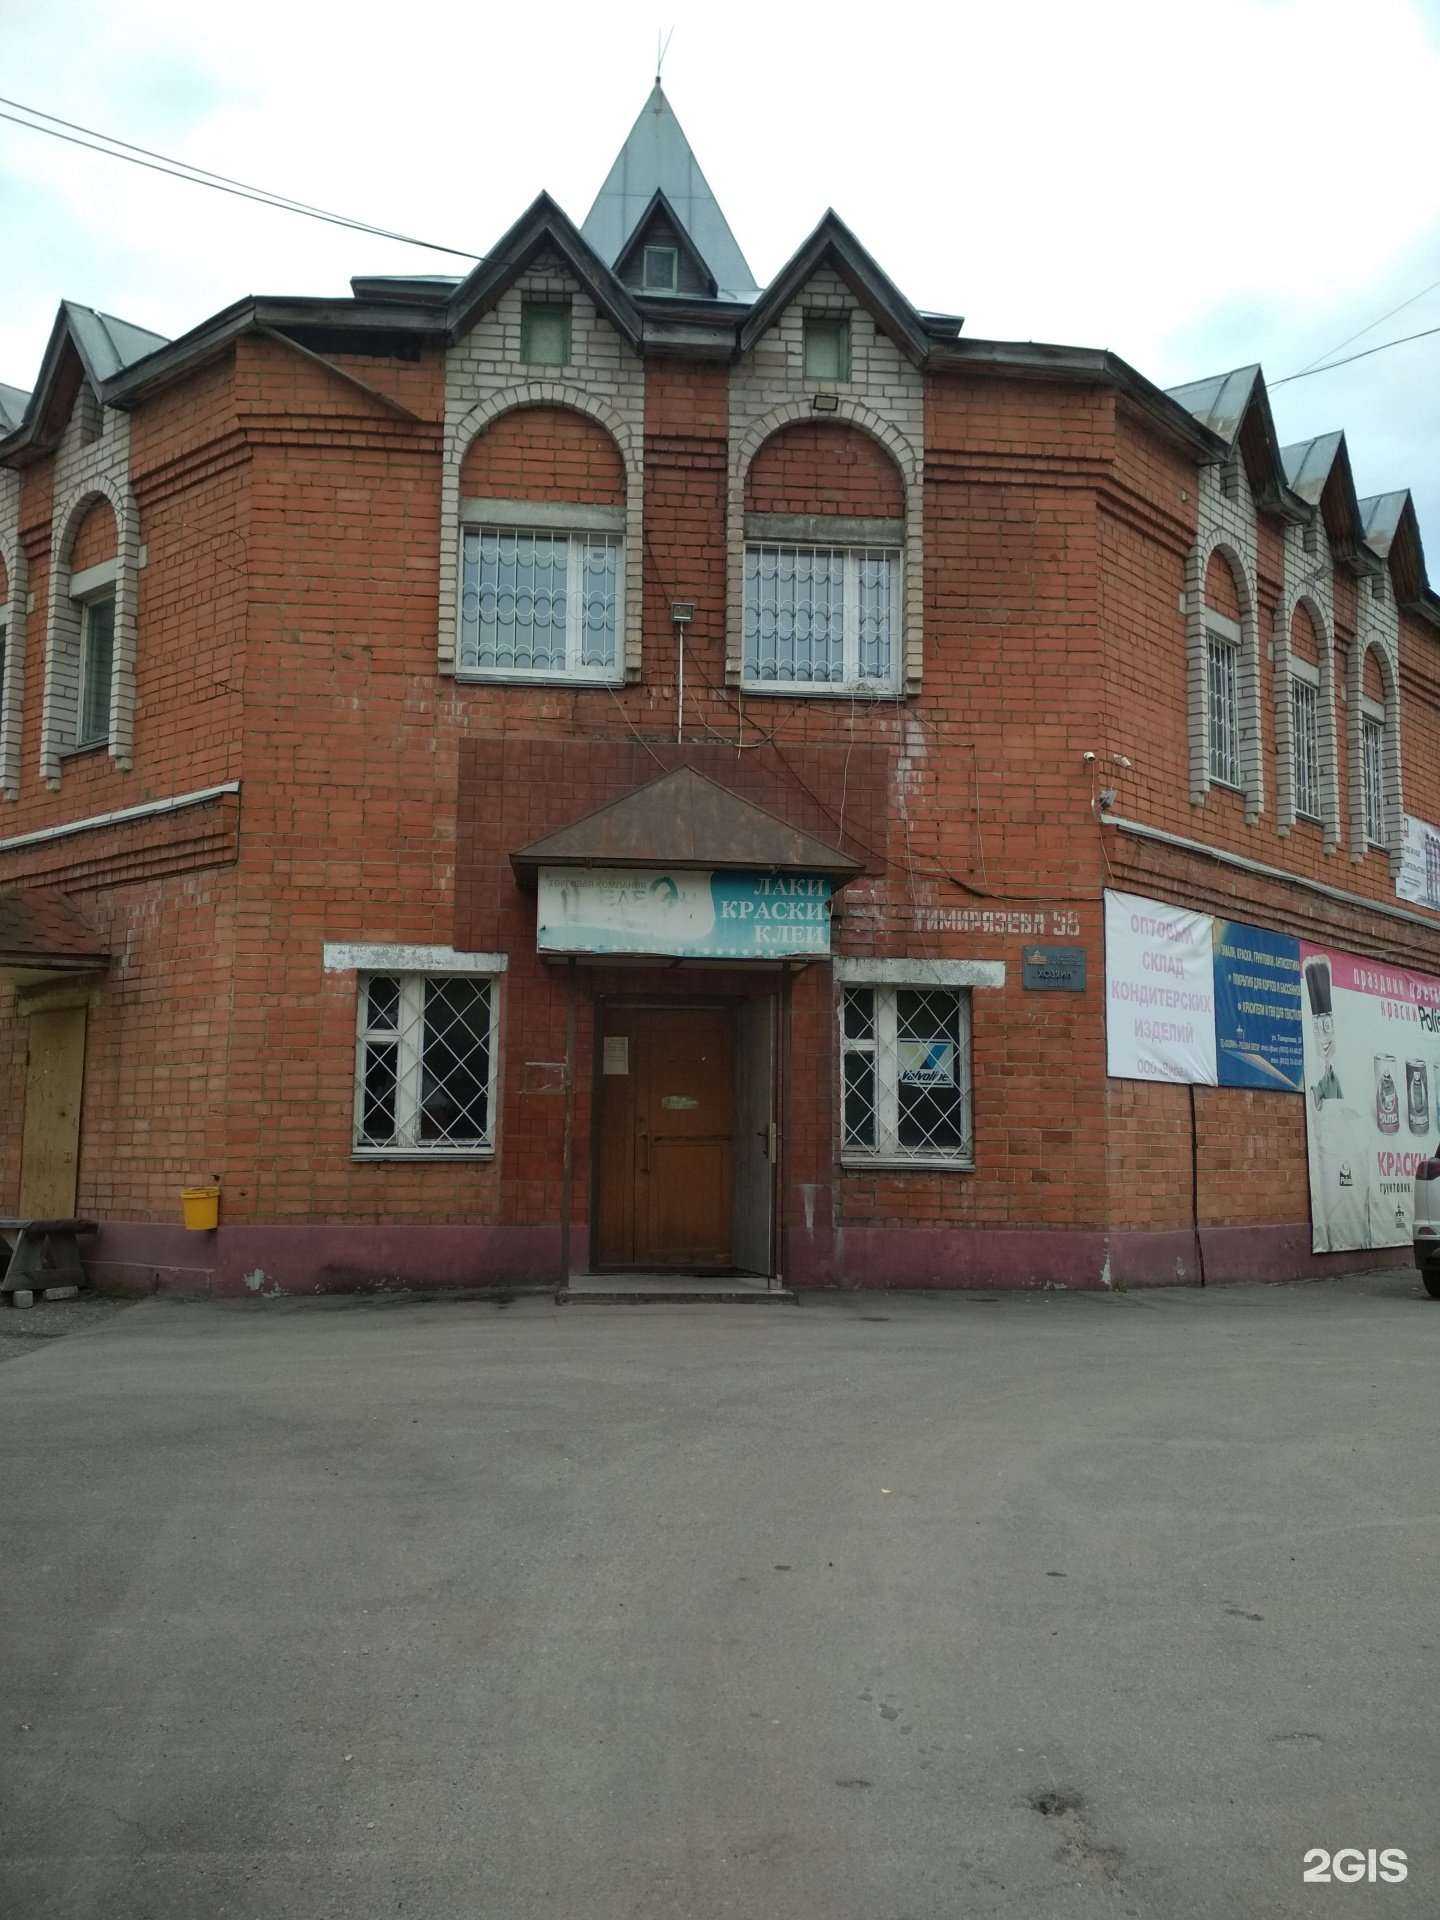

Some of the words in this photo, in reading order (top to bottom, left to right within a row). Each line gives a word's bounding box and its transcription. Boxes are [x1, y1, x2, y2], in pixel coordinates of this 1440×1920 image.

[753, 878, 824, 896] ЛАКИ
[720, 900, 824, 920] КРАСКИ
[753, 925, 824, 944] КЛЕИ
[1142, 952, 1185, 979] СКЛАД
[1111, 979, 1212, 1013] КОНДИТЕРСКИХ
[1133, 1018, 1194, 1044] ИЗДЕЛИЙ
